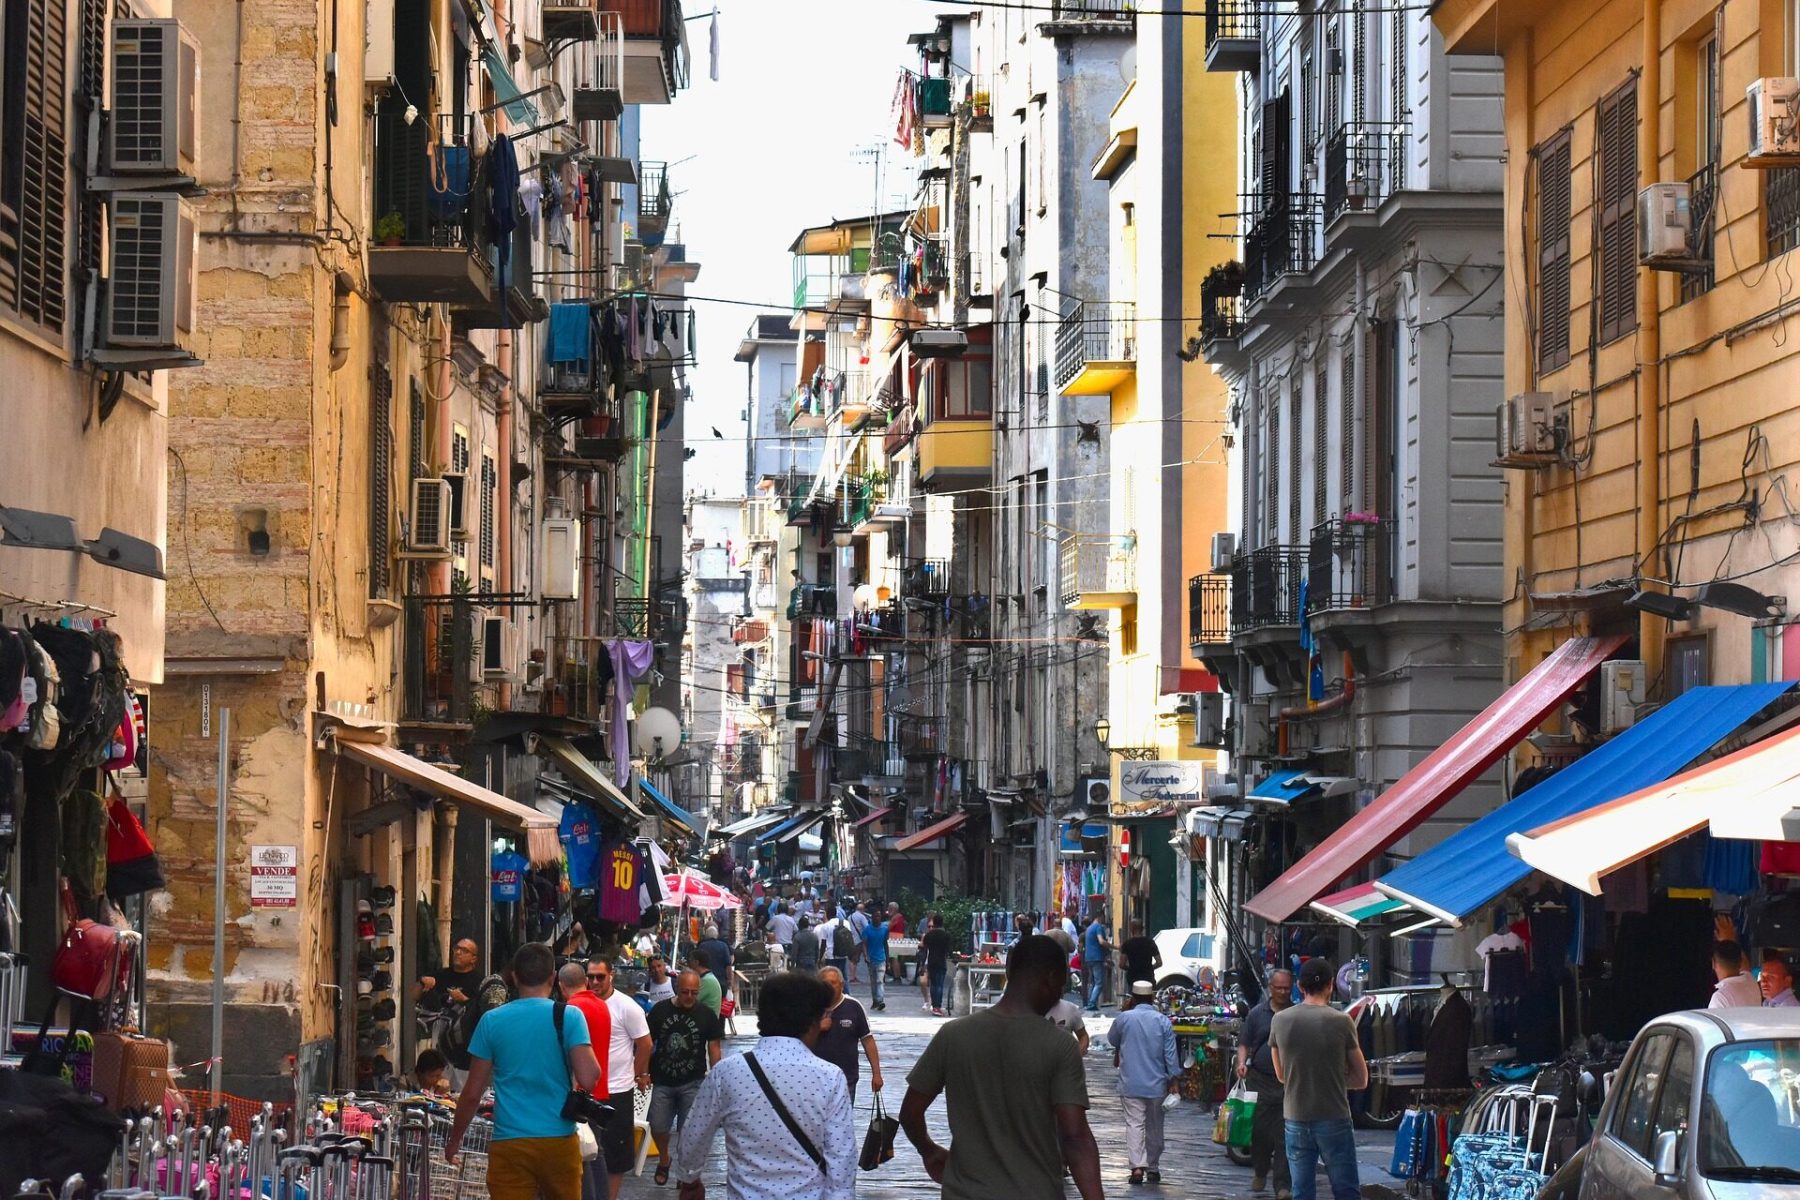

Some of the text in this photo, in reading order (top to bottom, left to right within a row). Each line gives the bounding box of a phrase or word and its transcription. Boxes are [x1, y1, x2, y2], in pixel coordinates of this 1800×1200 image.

[1123, 769, 1180, 785] Mercerie
[1140, 785, 1199, 800] Foderami
[613, 850, 633, 862] MESSI
[612, 860, 633, 890] 10
